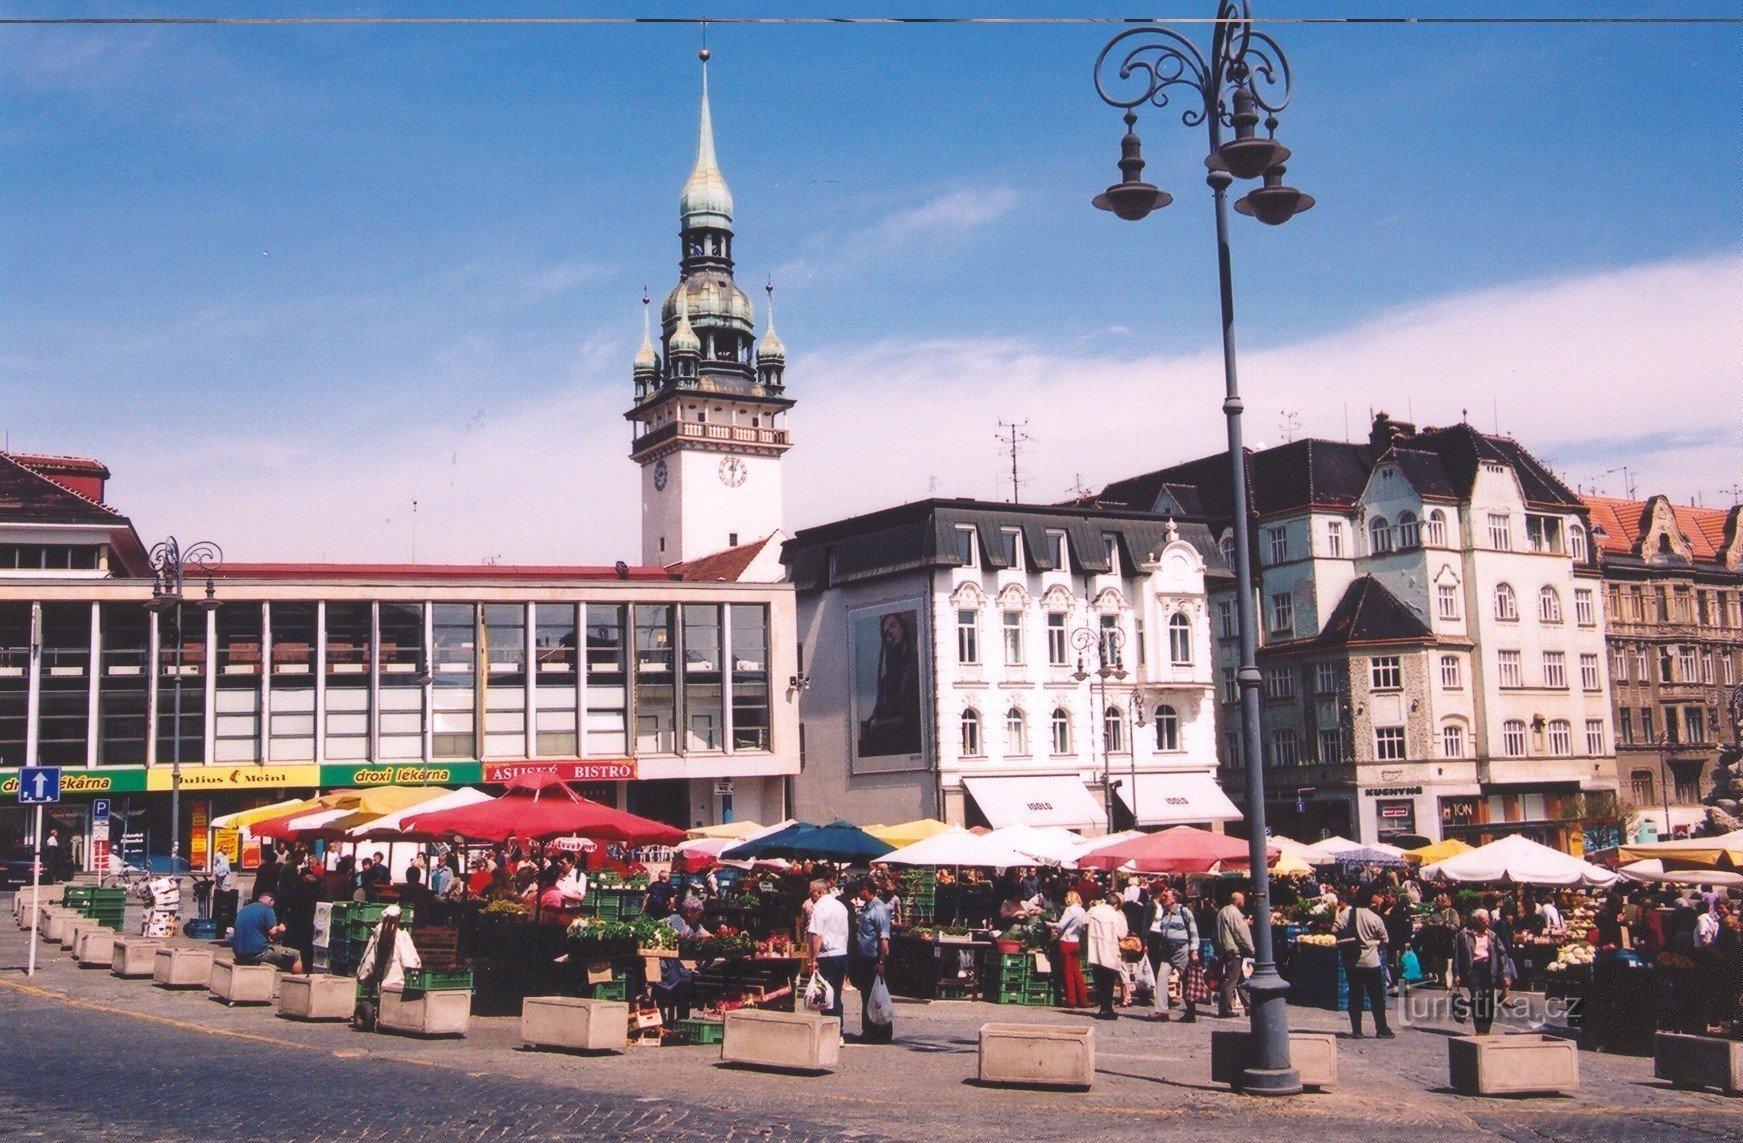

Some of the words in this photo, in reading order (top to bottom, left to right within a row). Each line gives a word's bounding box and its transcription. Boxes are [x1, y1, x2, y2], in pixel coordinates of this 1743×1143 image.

[245, 773, 286, 783] Meinl
[355, 767, 393, 782] droxi
[396, 765, 450, 781] lékárna
[574, 765, 631, 779] BISTRO
[60, 775, 110, 790] ékárna
[97, 802, 106, 814] P
